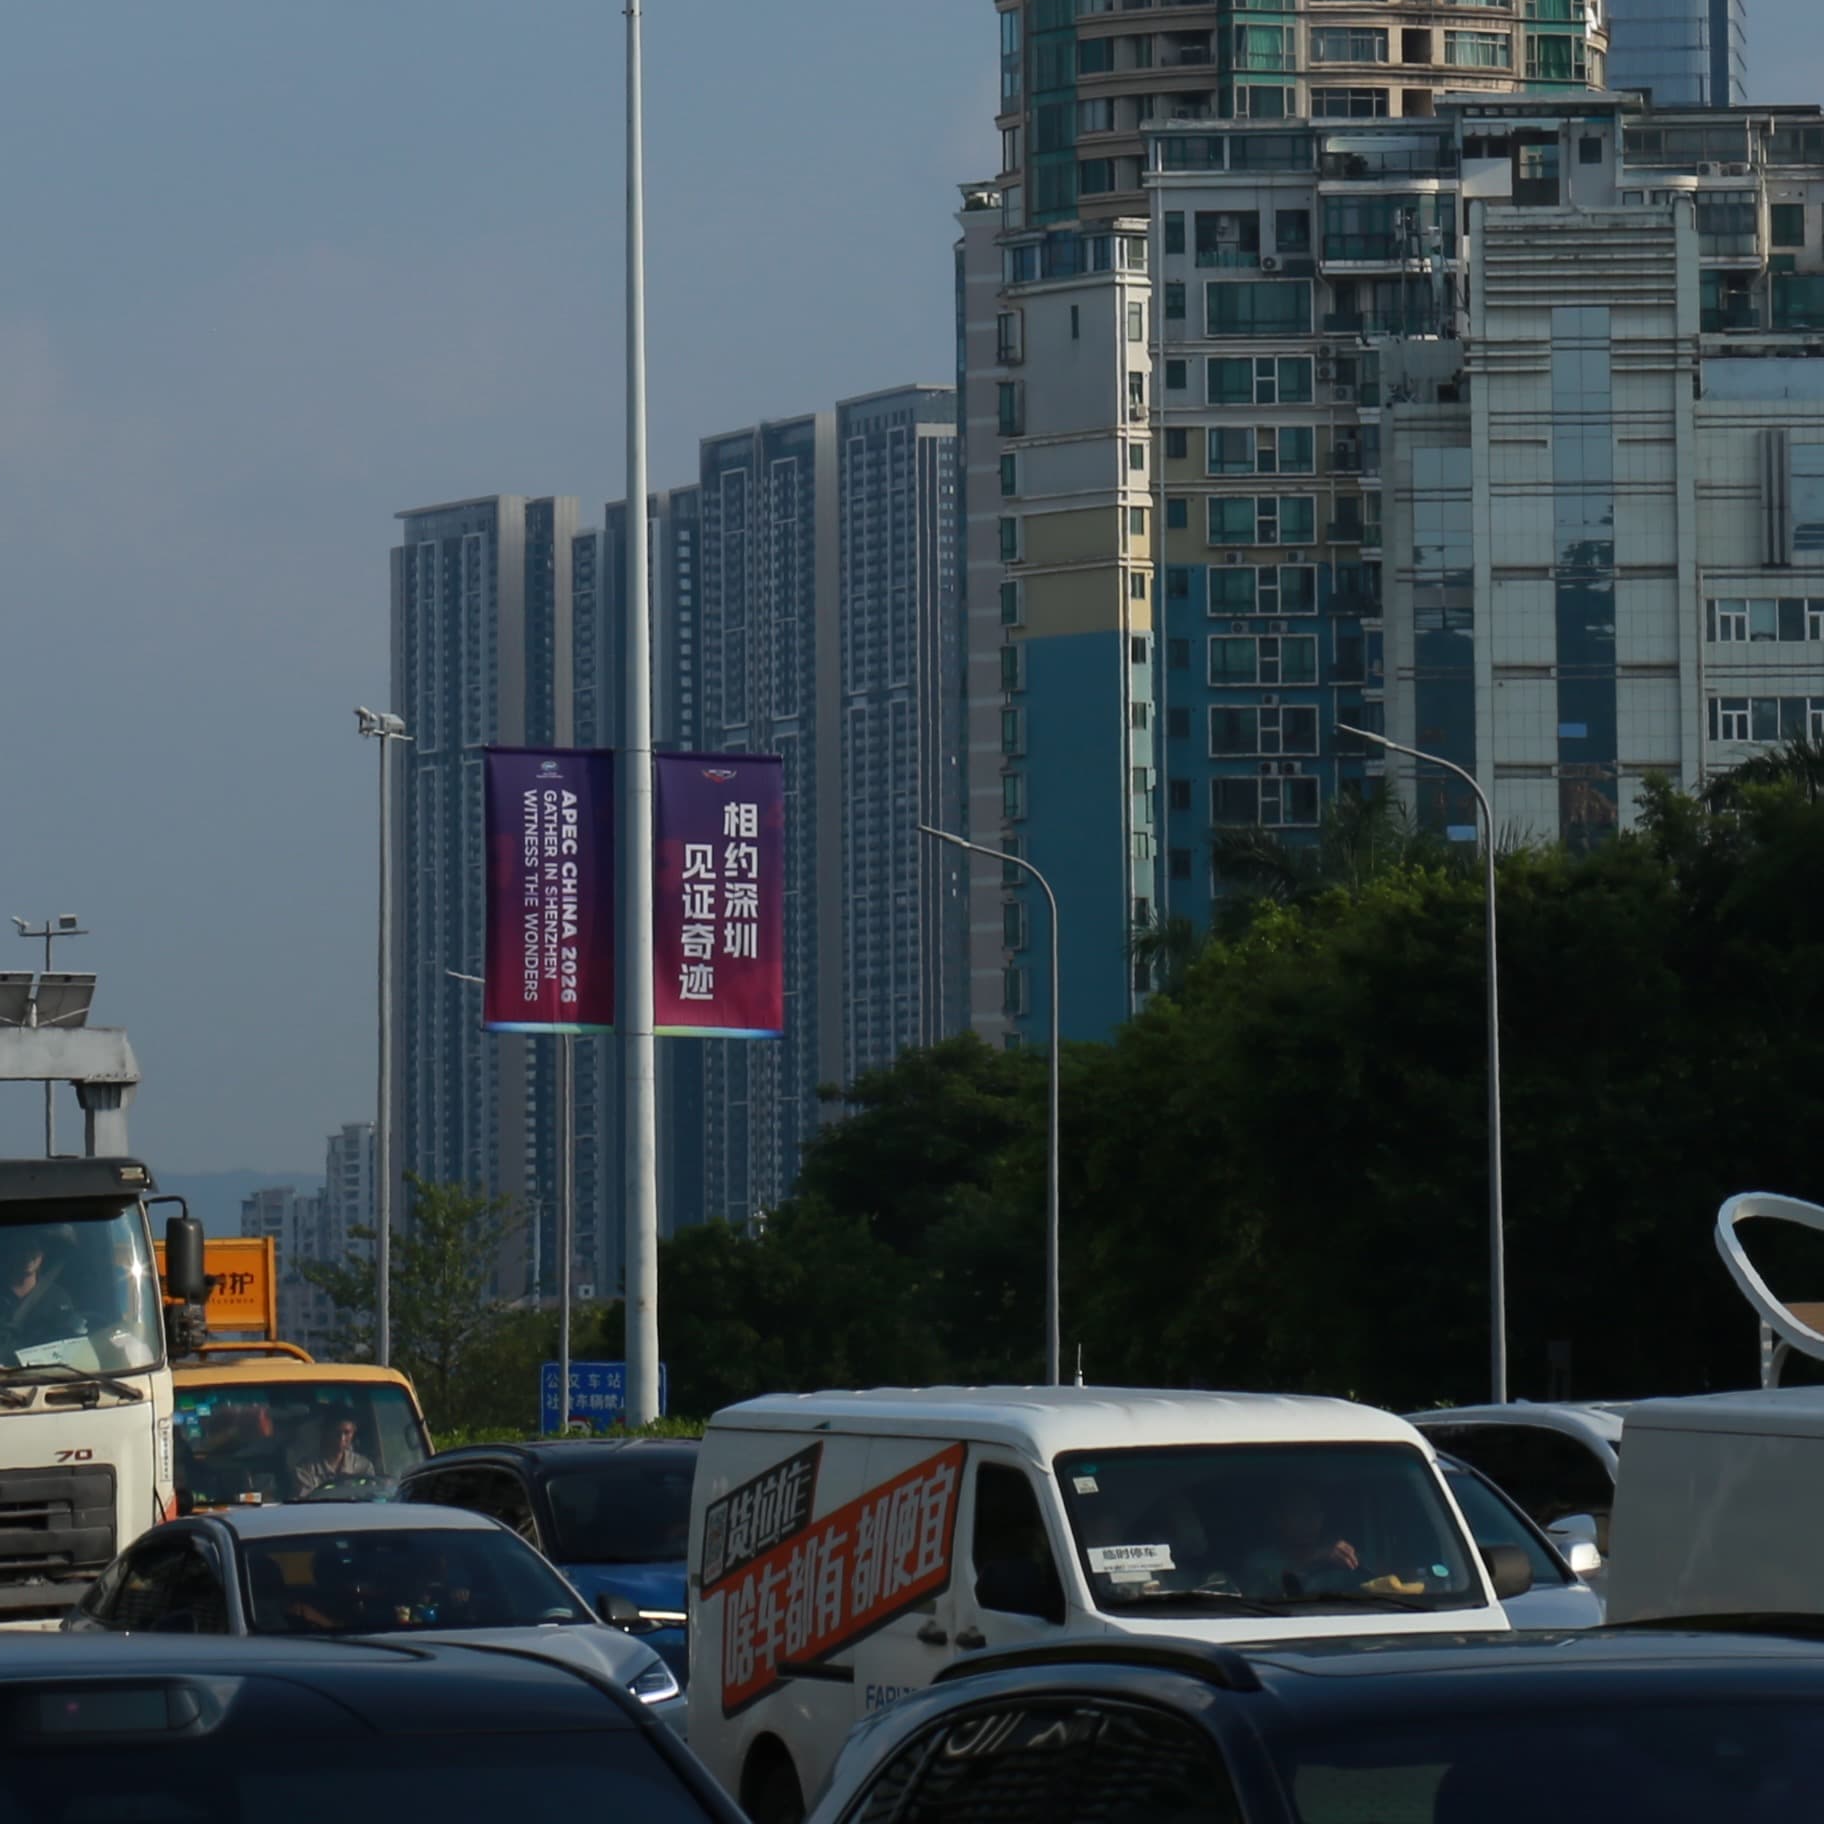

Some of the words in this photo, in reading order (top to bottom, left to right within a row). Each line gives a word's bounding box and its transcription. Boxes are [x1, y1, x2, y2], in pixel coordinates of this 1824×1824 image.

[523, 788, 539, 868] WITNESS
[544, 789, 558, 857] GATHER
[561, 789, 578, 856] APEC
[524, 872, 539, 908] THE
[544, 863, 558, 880] IN
[561, 861, 579, 939] CHINA
[722, 801, 759, 960] 相约深圳
[524, 912, 539, 1003] WONDERS
[543, 885, 559, 980] SHENZHEN
[678, 843, 717, 1001] 见证奇迹
[560, 946, 578, 1004] 2026
[727, 1461, 813, 1567] 货拉拉
[727, 1526, 849, 1687] 啥车都有
[850, 1462, 956, 1617] 都便宜
